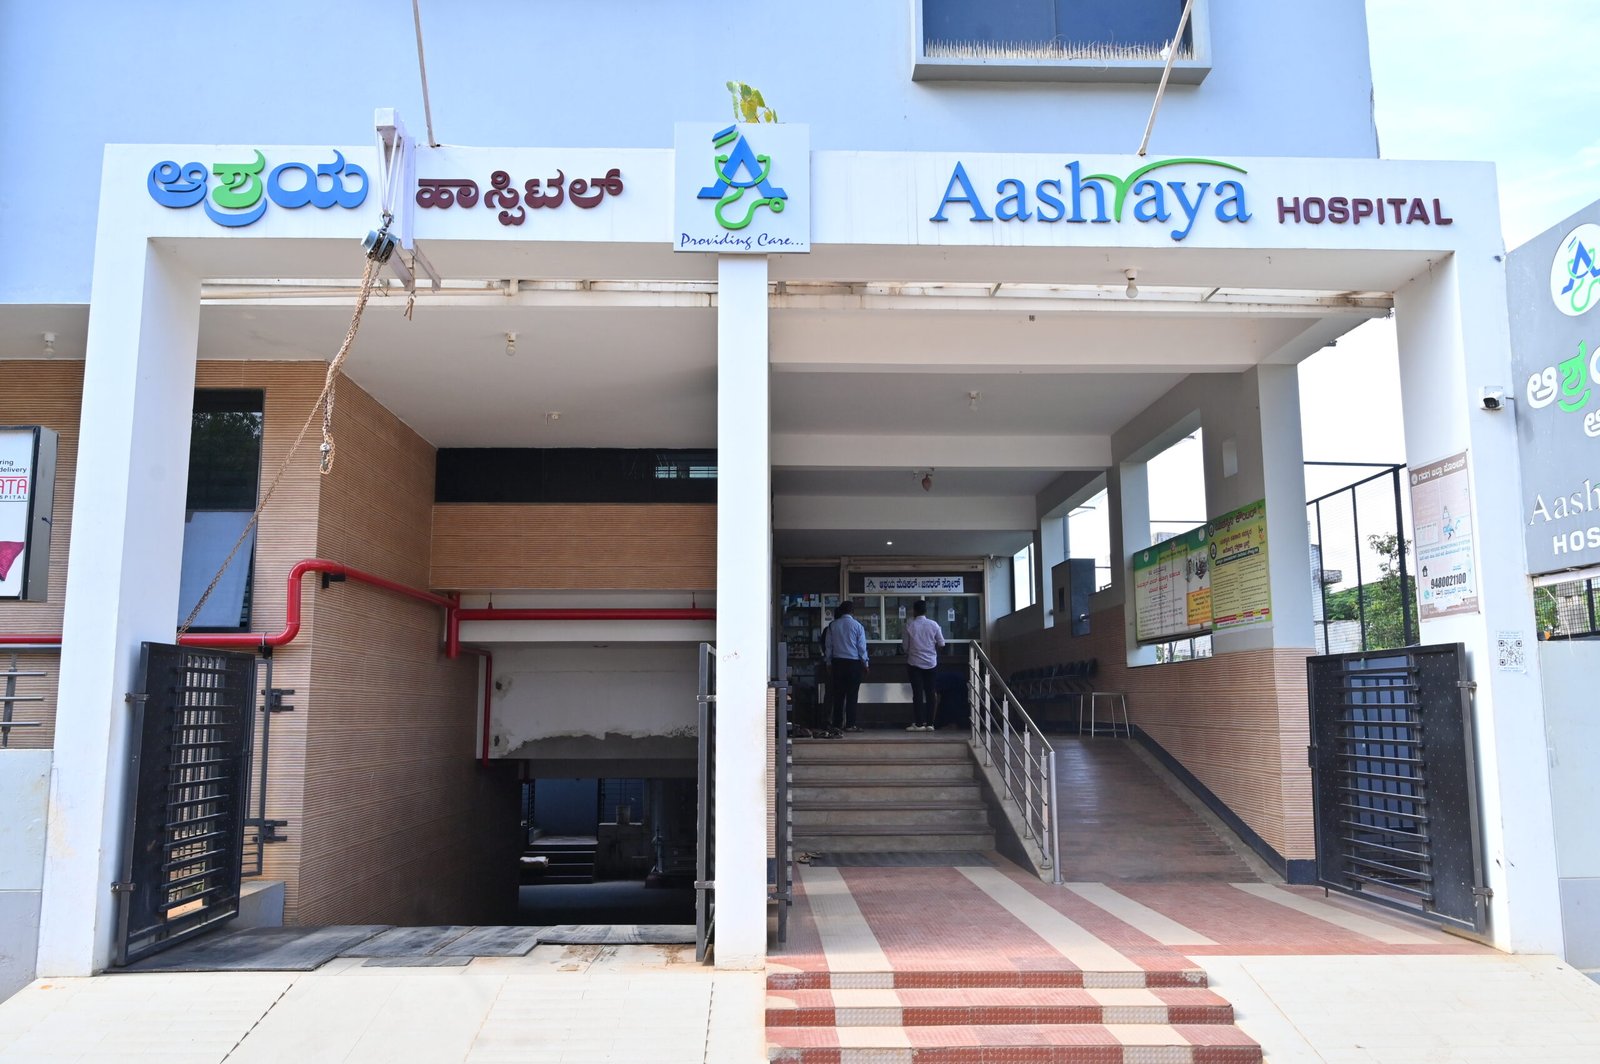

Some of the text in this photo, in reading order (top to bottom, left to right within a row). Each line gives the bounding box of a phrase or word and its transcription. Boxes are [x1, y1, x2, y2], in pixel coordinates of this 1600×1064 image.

[147, 149, 624, 227] ಆಶ್ರಯ ಹಾಸ್ಪಿಟಲ್
[929, 157, 1454, 241] Aashraya HOSPITAL
[680, 232, 753, 250] Providing
[1527, 340, 1600, 413] ಆಶ್ರ
[1528, 479, 1600, 526] Aash
[1553, 527, 1600, 555] HOS
